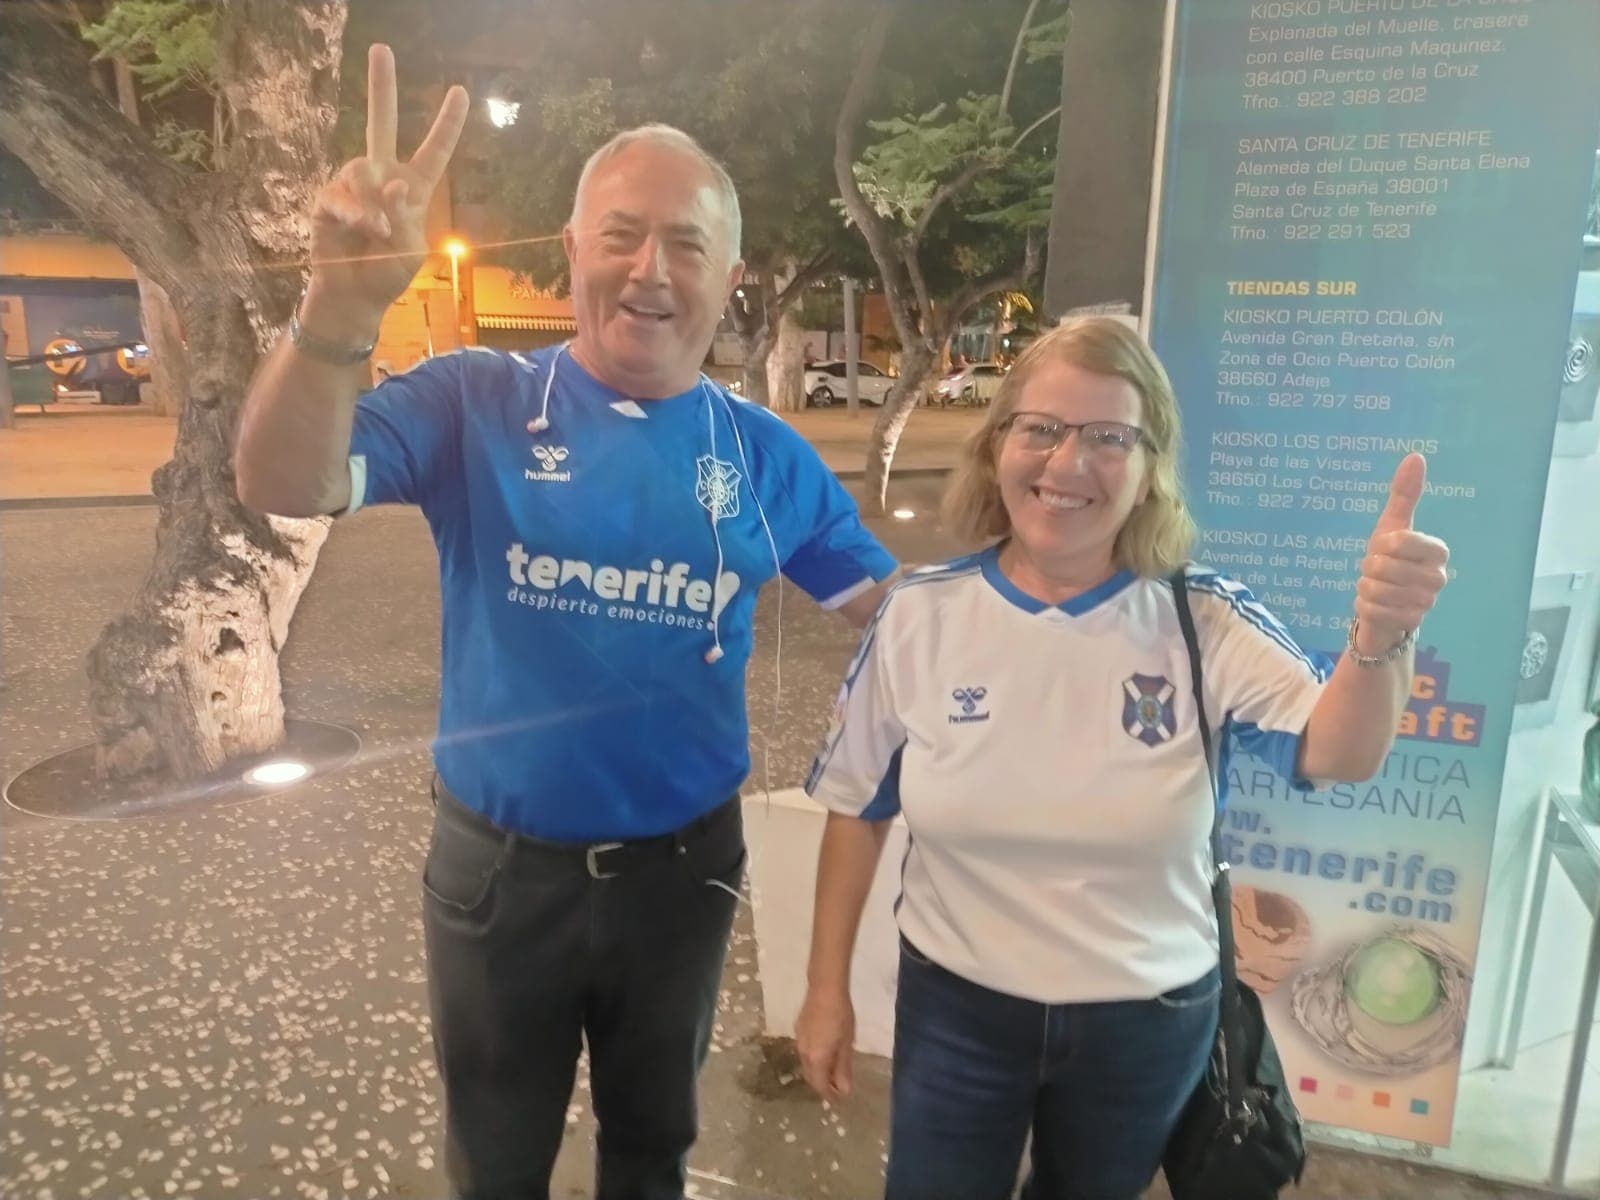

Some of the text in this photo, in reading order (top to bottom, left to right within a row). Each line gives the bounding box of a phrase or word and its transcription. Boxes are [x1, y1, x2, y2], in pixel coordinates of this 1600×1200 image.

[1250, 0, 1321, 19] KIOSKO
[1327, 0, 1405, 14] PUERTO
[1248, 22, 1338, 42] Explanada
[1344, 20, 1371, 37] del
[1453, 13, 1529, 31] trasera
[1245, 51, 1277, 65] con
[1283, 46, 1324, 63] calle
[1331, 43, 1403, 62] Esquina
[1244, 61, 1480, 88] 38400 Puerto de la Cruz
[1297, 90, 1336, 108] 922
[1342, 88, 1381, 106] 388
[1386, 85, 1427, 104] 202
[1238, 128, 1493, 155] SANTA CRUZ DE TENERIFE
[1235, 152, 1531, 176] Alameda del Duque Santa Elena
[1234, 177, 1449, 199] Plaza de España 38001
[1232, 200, 1438, 220] Santa Cruz de Tenerife
[1284, 223, 1322, 240] 922
[1327, 222, 1363, 240] 291
[1371, 222, 1411, 239] 523
[1226, 280, 1358, 297] TIENDAS SUR
[1222, 307, 1445, 327] KIOSKO PUERTO COLÓN
[1221, 329, 1287, 346] Avenida
[1292, 329, 1335, 346] Gran
[1426, 333, 1456, 350] s/n
[1218, 350, 1456, 370] Zona de Ocio Puerto Colón
[1217, 370, 1332, 391] 38660 Adeje
[1268, 391, 1305, 408] 922
[1311, 392, 1347, 409] 797
[1352, 393, 1392, 411] 508
[1211, 430, 1439, 455] KIOSKO LOS CRISTIANOS
[1209, 451, 1372, 473] Playa de las Vistas
[524, 467, 572, 483] hummel
[1207, 471, 1476, 499] 38650 Los Cristiano Arona
[1257, 492, 1295, 509] 922
[1300, 495, 1337, 512] 750
[1341, 497, 1380, 514] 098
[1202, 529, 1366, 554] KIOSKO LAS AMÉR
[1200, 549, 1263, 567] Avenida
[1268, 553, 1289, 568] de
[1295, 554, 1348, 572] Rafael
[1247, 570, 1266, 585] de
[1273, 572, 1303, 588] Las
[1309, 575, 1356, 593] Amér
[507, 586, 599, 616] despierta
[1261, 591, 1307, 610] Adeje
[1288, 612, 1322, 629] 794
[1328, 616, 1352, 631] 34
[1396, 704, 1477, 742] aft
[1229, 808, 1272, 836] w.
[1220, 832, 1457, 897] tenerife
[1347, 890, 1454, 924] .com
